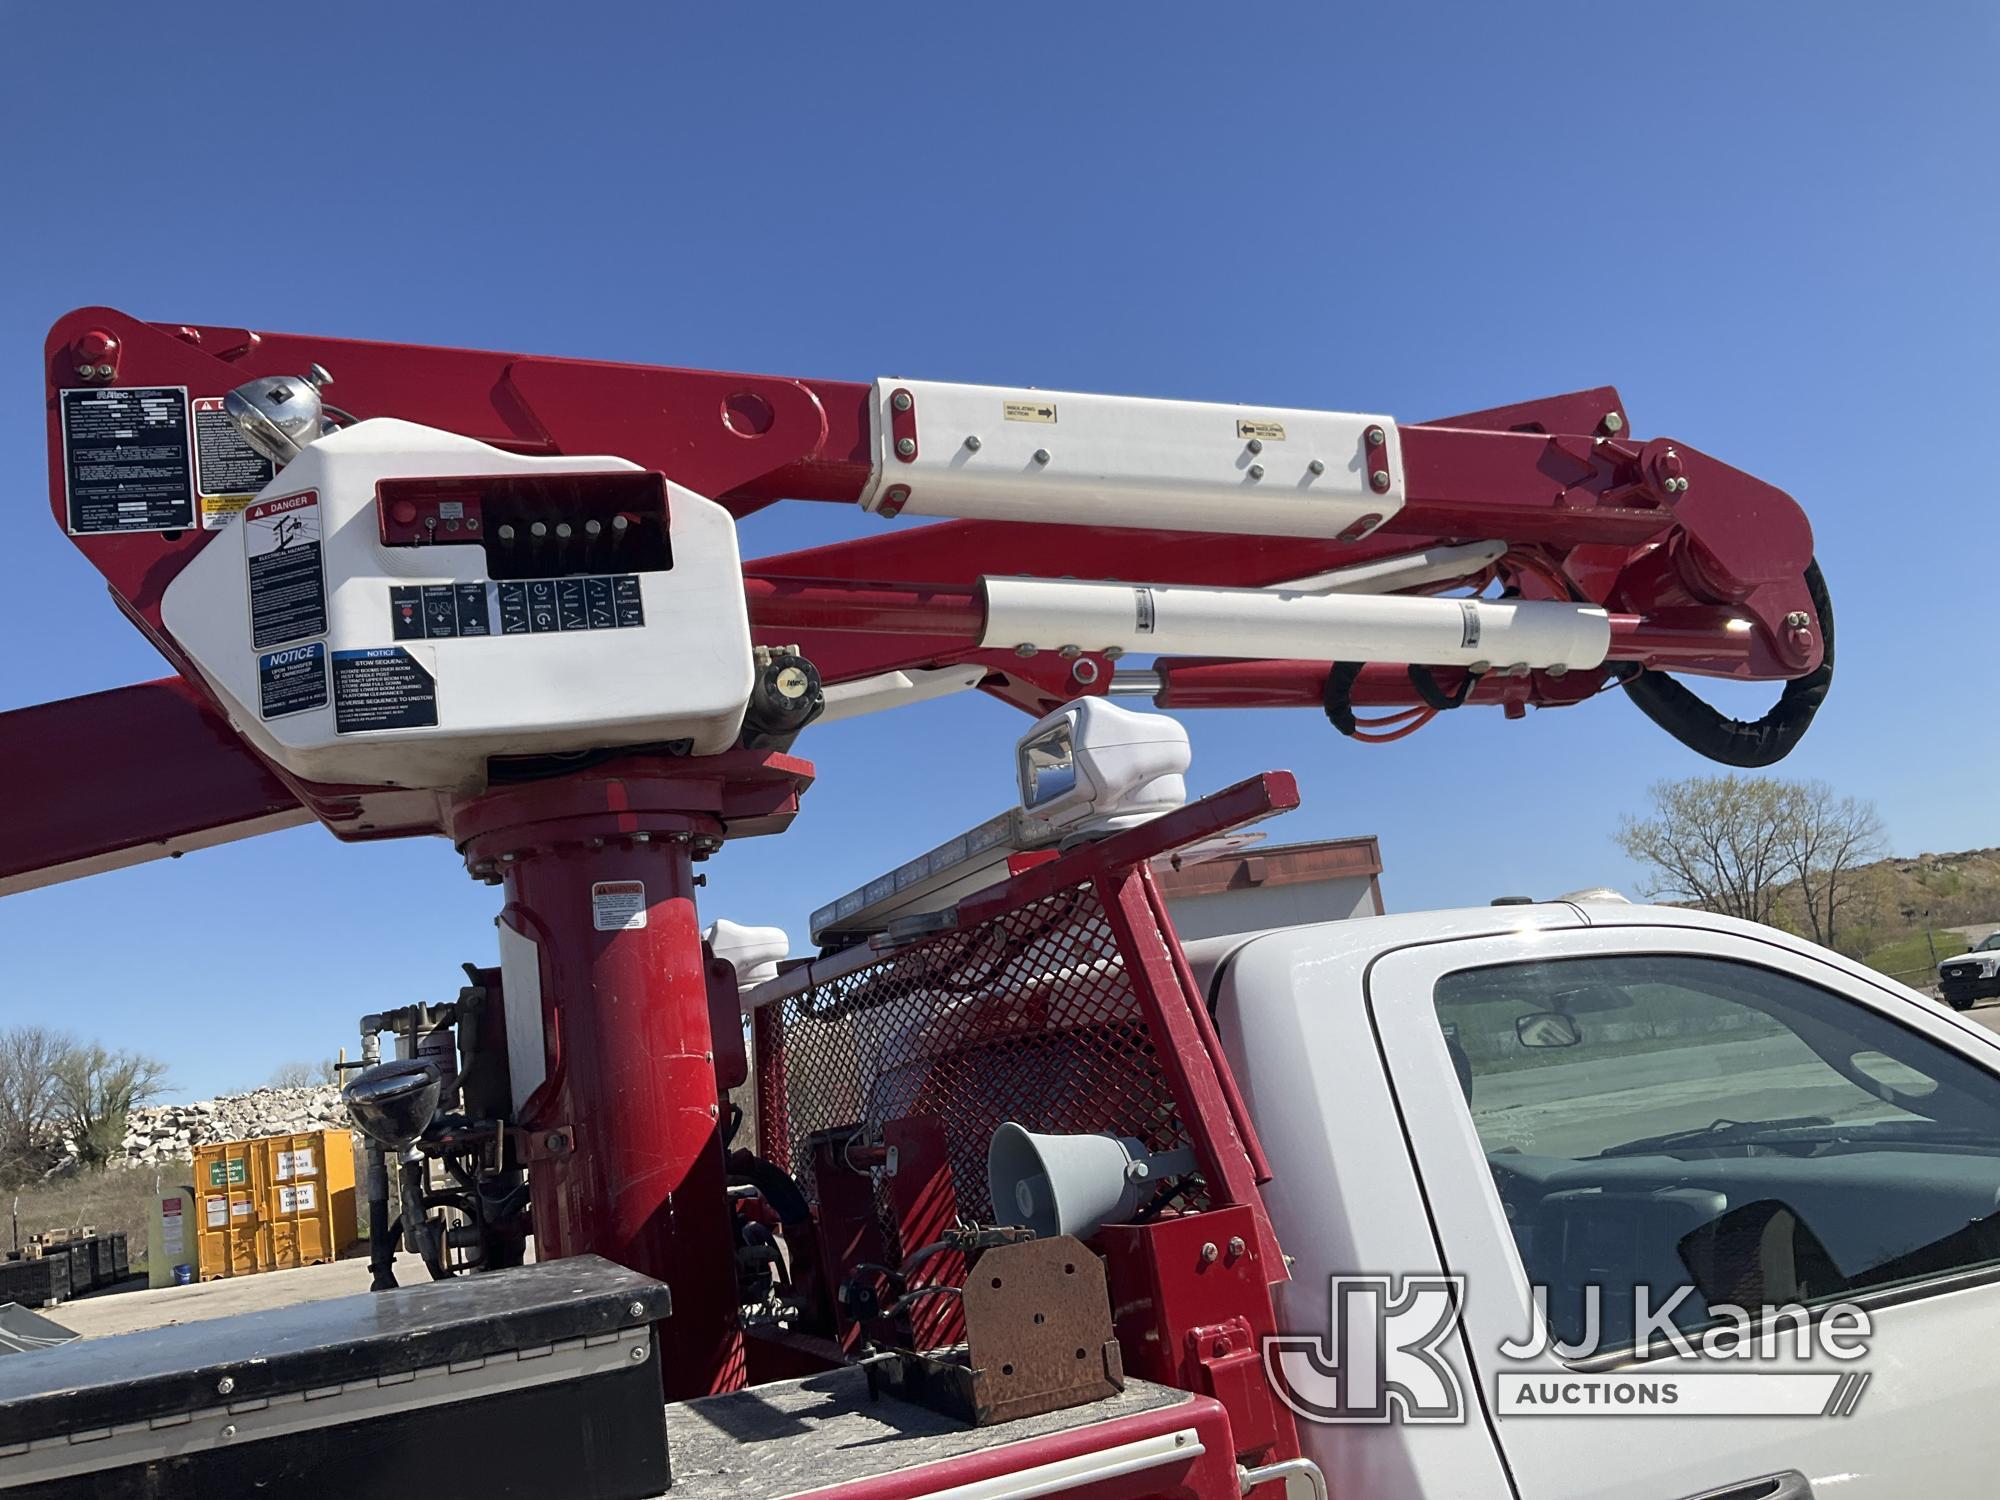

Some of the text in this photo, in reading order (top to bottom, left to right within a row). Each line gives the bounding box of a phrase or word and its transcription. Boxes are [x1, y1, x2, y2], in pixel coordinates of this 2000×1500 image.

[271, 497, 307, 512] DANGER
[270, 646, 315, 666] NOTICE
[287, 661, 312, 671] TRANSFER
